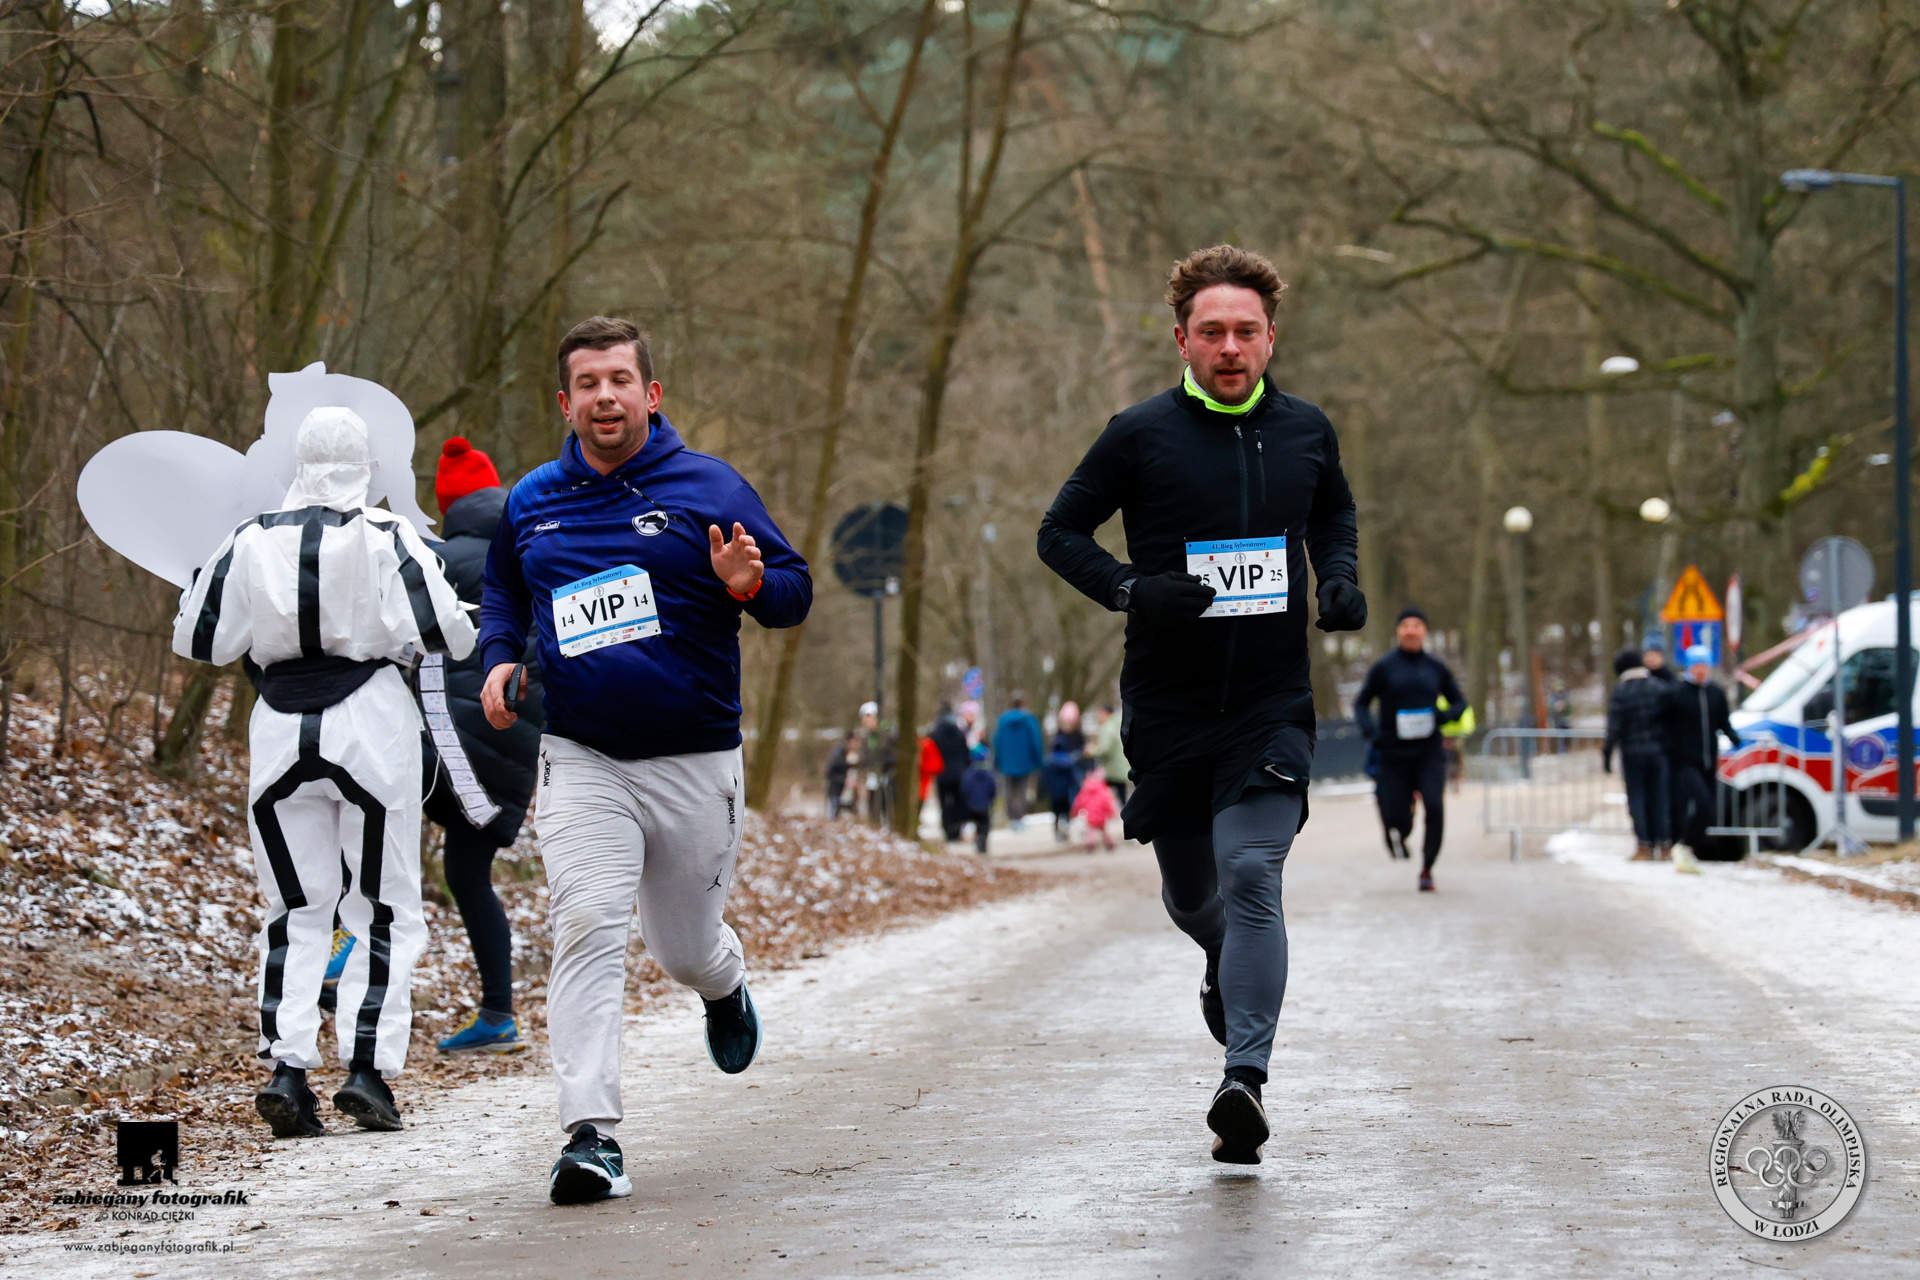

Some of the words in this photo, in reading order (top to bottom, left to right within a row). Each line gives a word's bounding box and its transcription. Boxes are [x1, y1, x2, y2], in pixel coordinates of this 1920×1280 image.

[1217, 564, 1264, 591] VIP
[1270, 569, 1283, 581] 25
[580, 593, 625, 626] VIP
[634, 593, 649, 608] 14
[562, 613, 575, 627] 14
[543, 759, 551, 787] JORDAN
[728, 796, 736, 824] JORDAN
